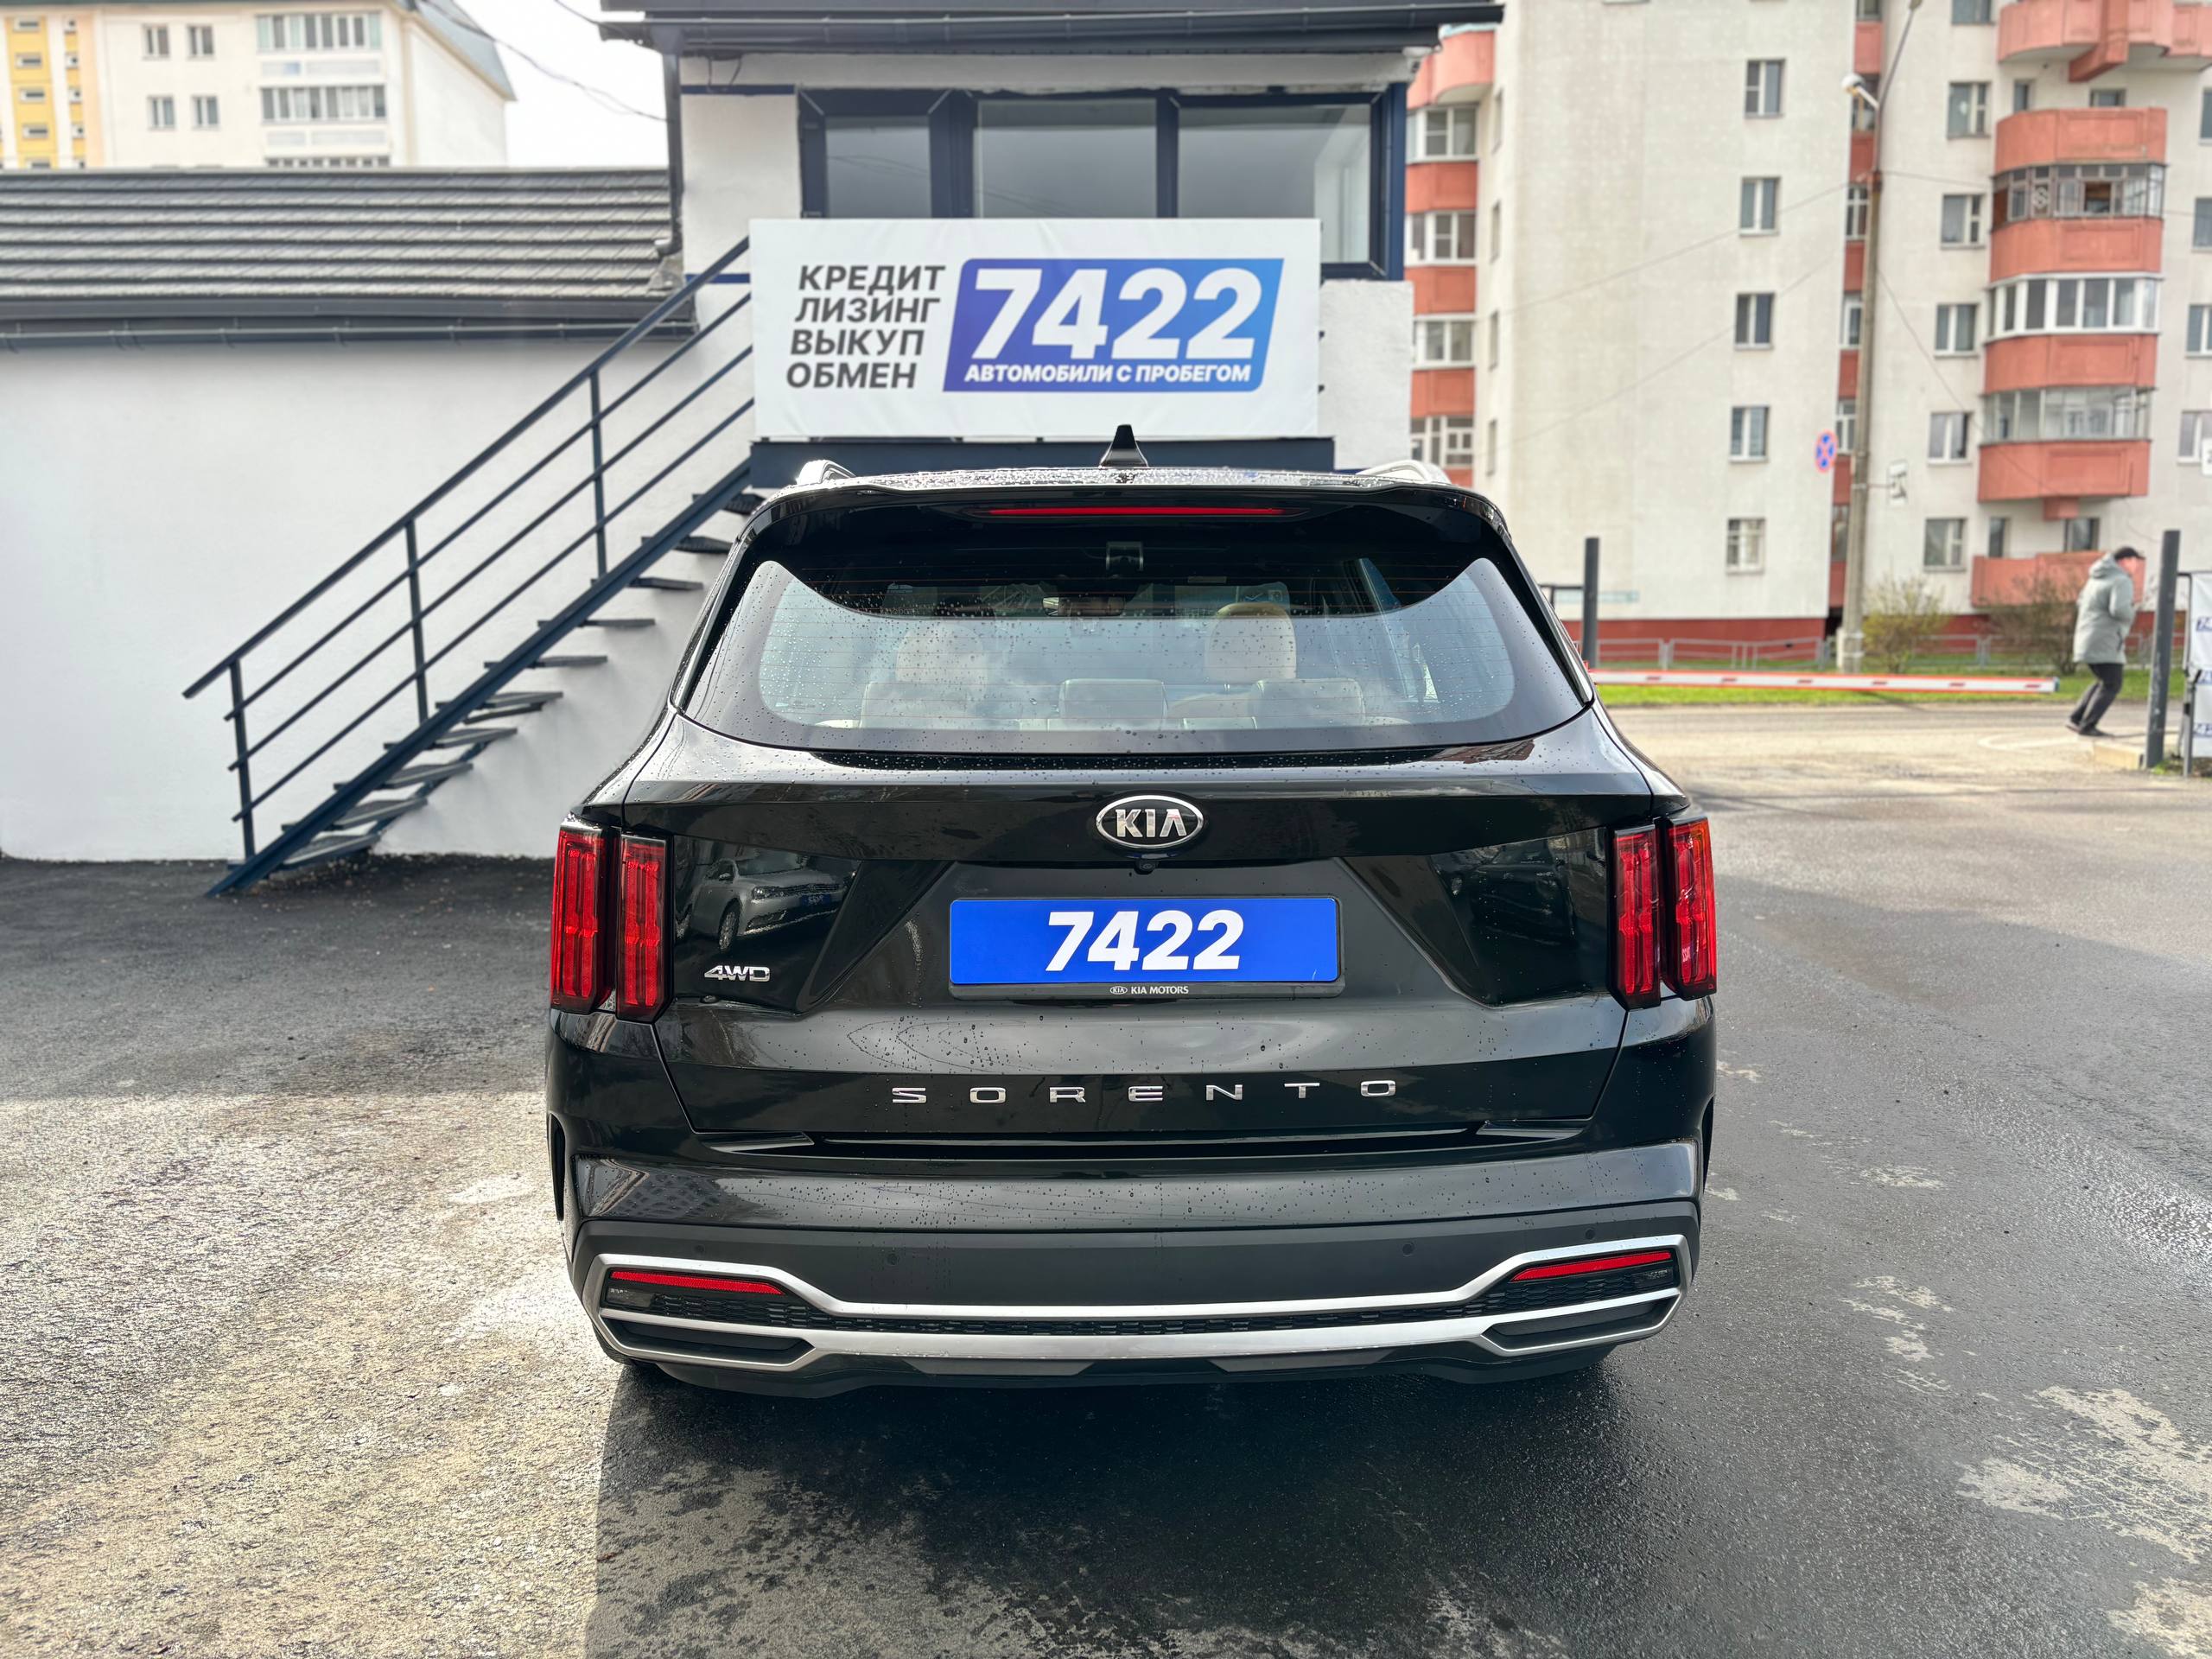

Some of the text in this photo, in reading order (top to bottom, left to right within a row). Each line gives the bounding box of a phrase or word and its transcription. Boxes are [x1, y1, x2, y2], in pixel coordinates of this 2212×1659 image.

[798, 265, 945, 296] КРЕДИТ
[794, 297, 941, 323] ЛИЗИНГ
[972, 268, 1262, 360] 7422
[790, 329, 925, 356] ВЫКУП
[785, 362, 917, 389] ОБМЕН
[964, 364, 1251, 383] АВТОМОБИЛИ С ПРОБЕГОМ
[1116, 808, 1188, 838] KIA
[1045, 909, 1244, 972] 7422
[703, 964, 771, 982] 4WD
[1130, 986, 1147, 995] KIA
[1149, 985, 1189, 995] MOTORS
[892, 1079, 1396, 1104] SORENTO
